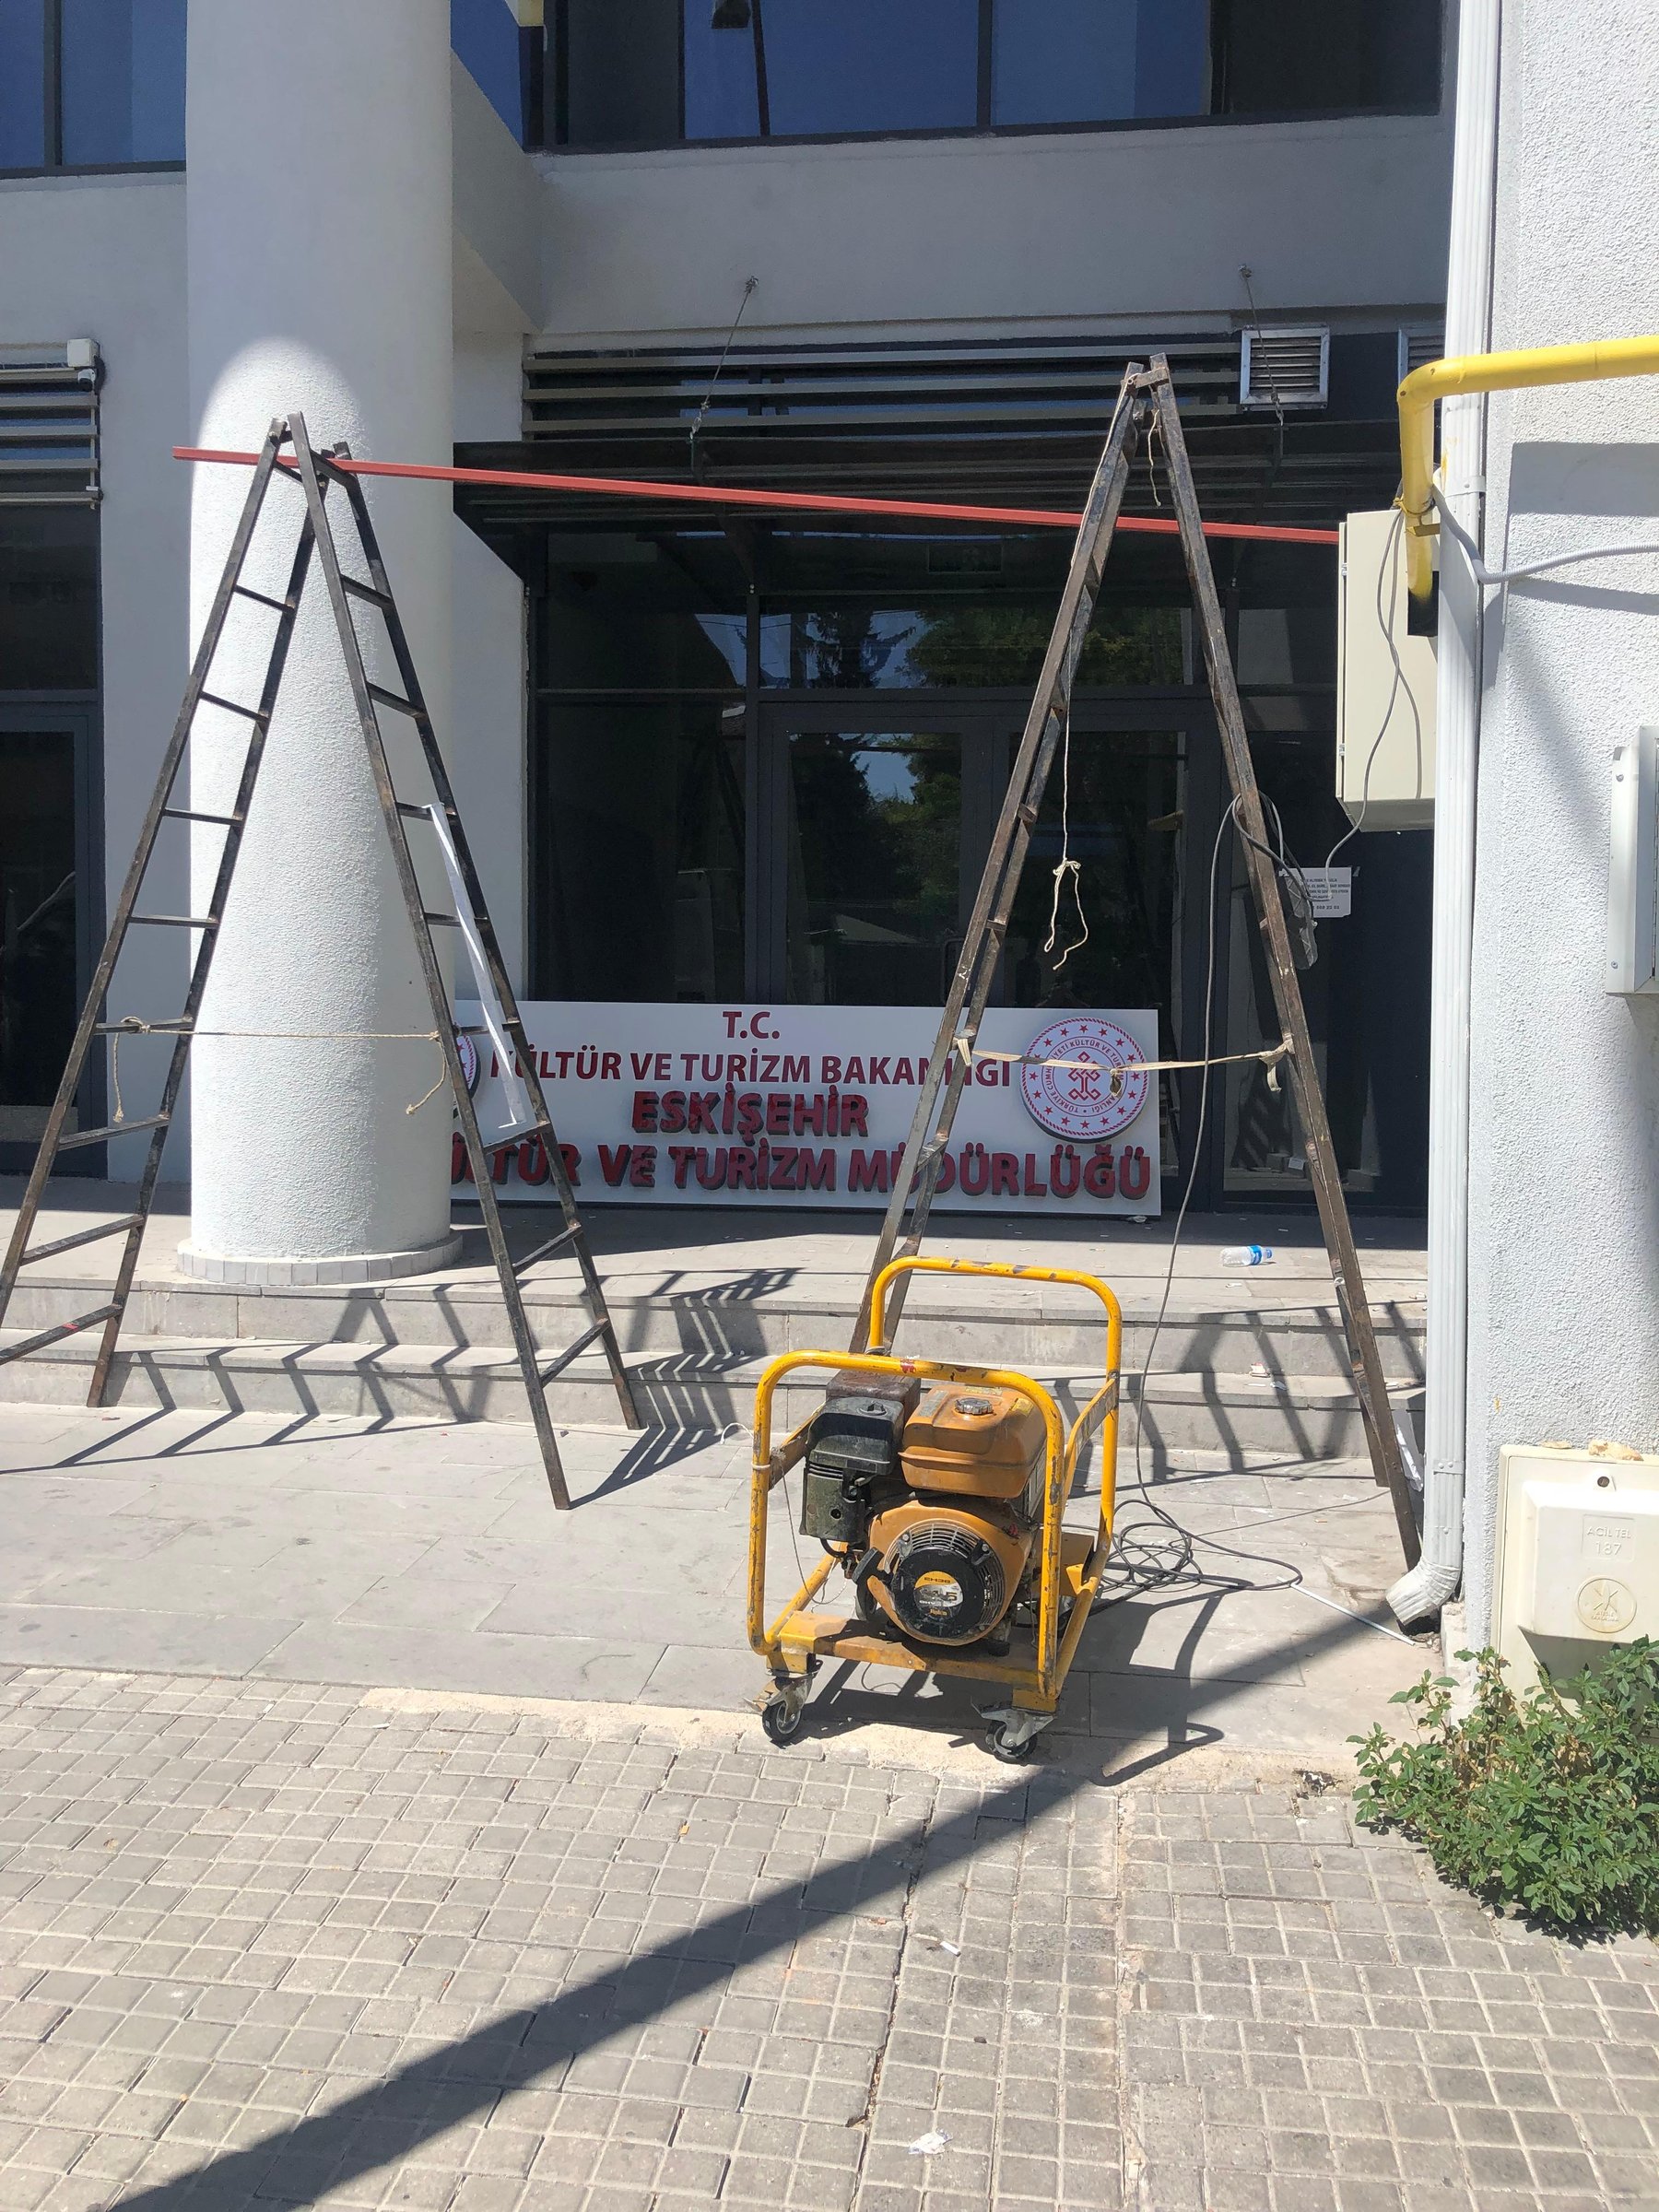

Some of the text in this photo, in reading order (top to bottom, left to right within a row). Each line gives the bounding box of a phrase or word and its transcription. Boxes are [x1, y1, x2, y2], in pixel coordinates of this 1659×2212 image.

[722, 1010, 781, 1040] T.C.
[630, 1052, 672, 1081] VE
[680, 1046, 811, 1084] TURİZM
[1045, 1043, 1068, 1090] CUMHİYETİ
[1070, 1039, 1100, 1048] KÜLTÜR
[1101, 1044, 1112, 1054] VE
[631, 1081, 869, 1147] ESKİŞEHİR
[597, 1143, 659, 1188] VE
[667, 1136, 838, 1192] TURİZM
[1586, 1525, 1631, 1539] ACİL TEL
[1594, 1541, 1622, 1556] 187
